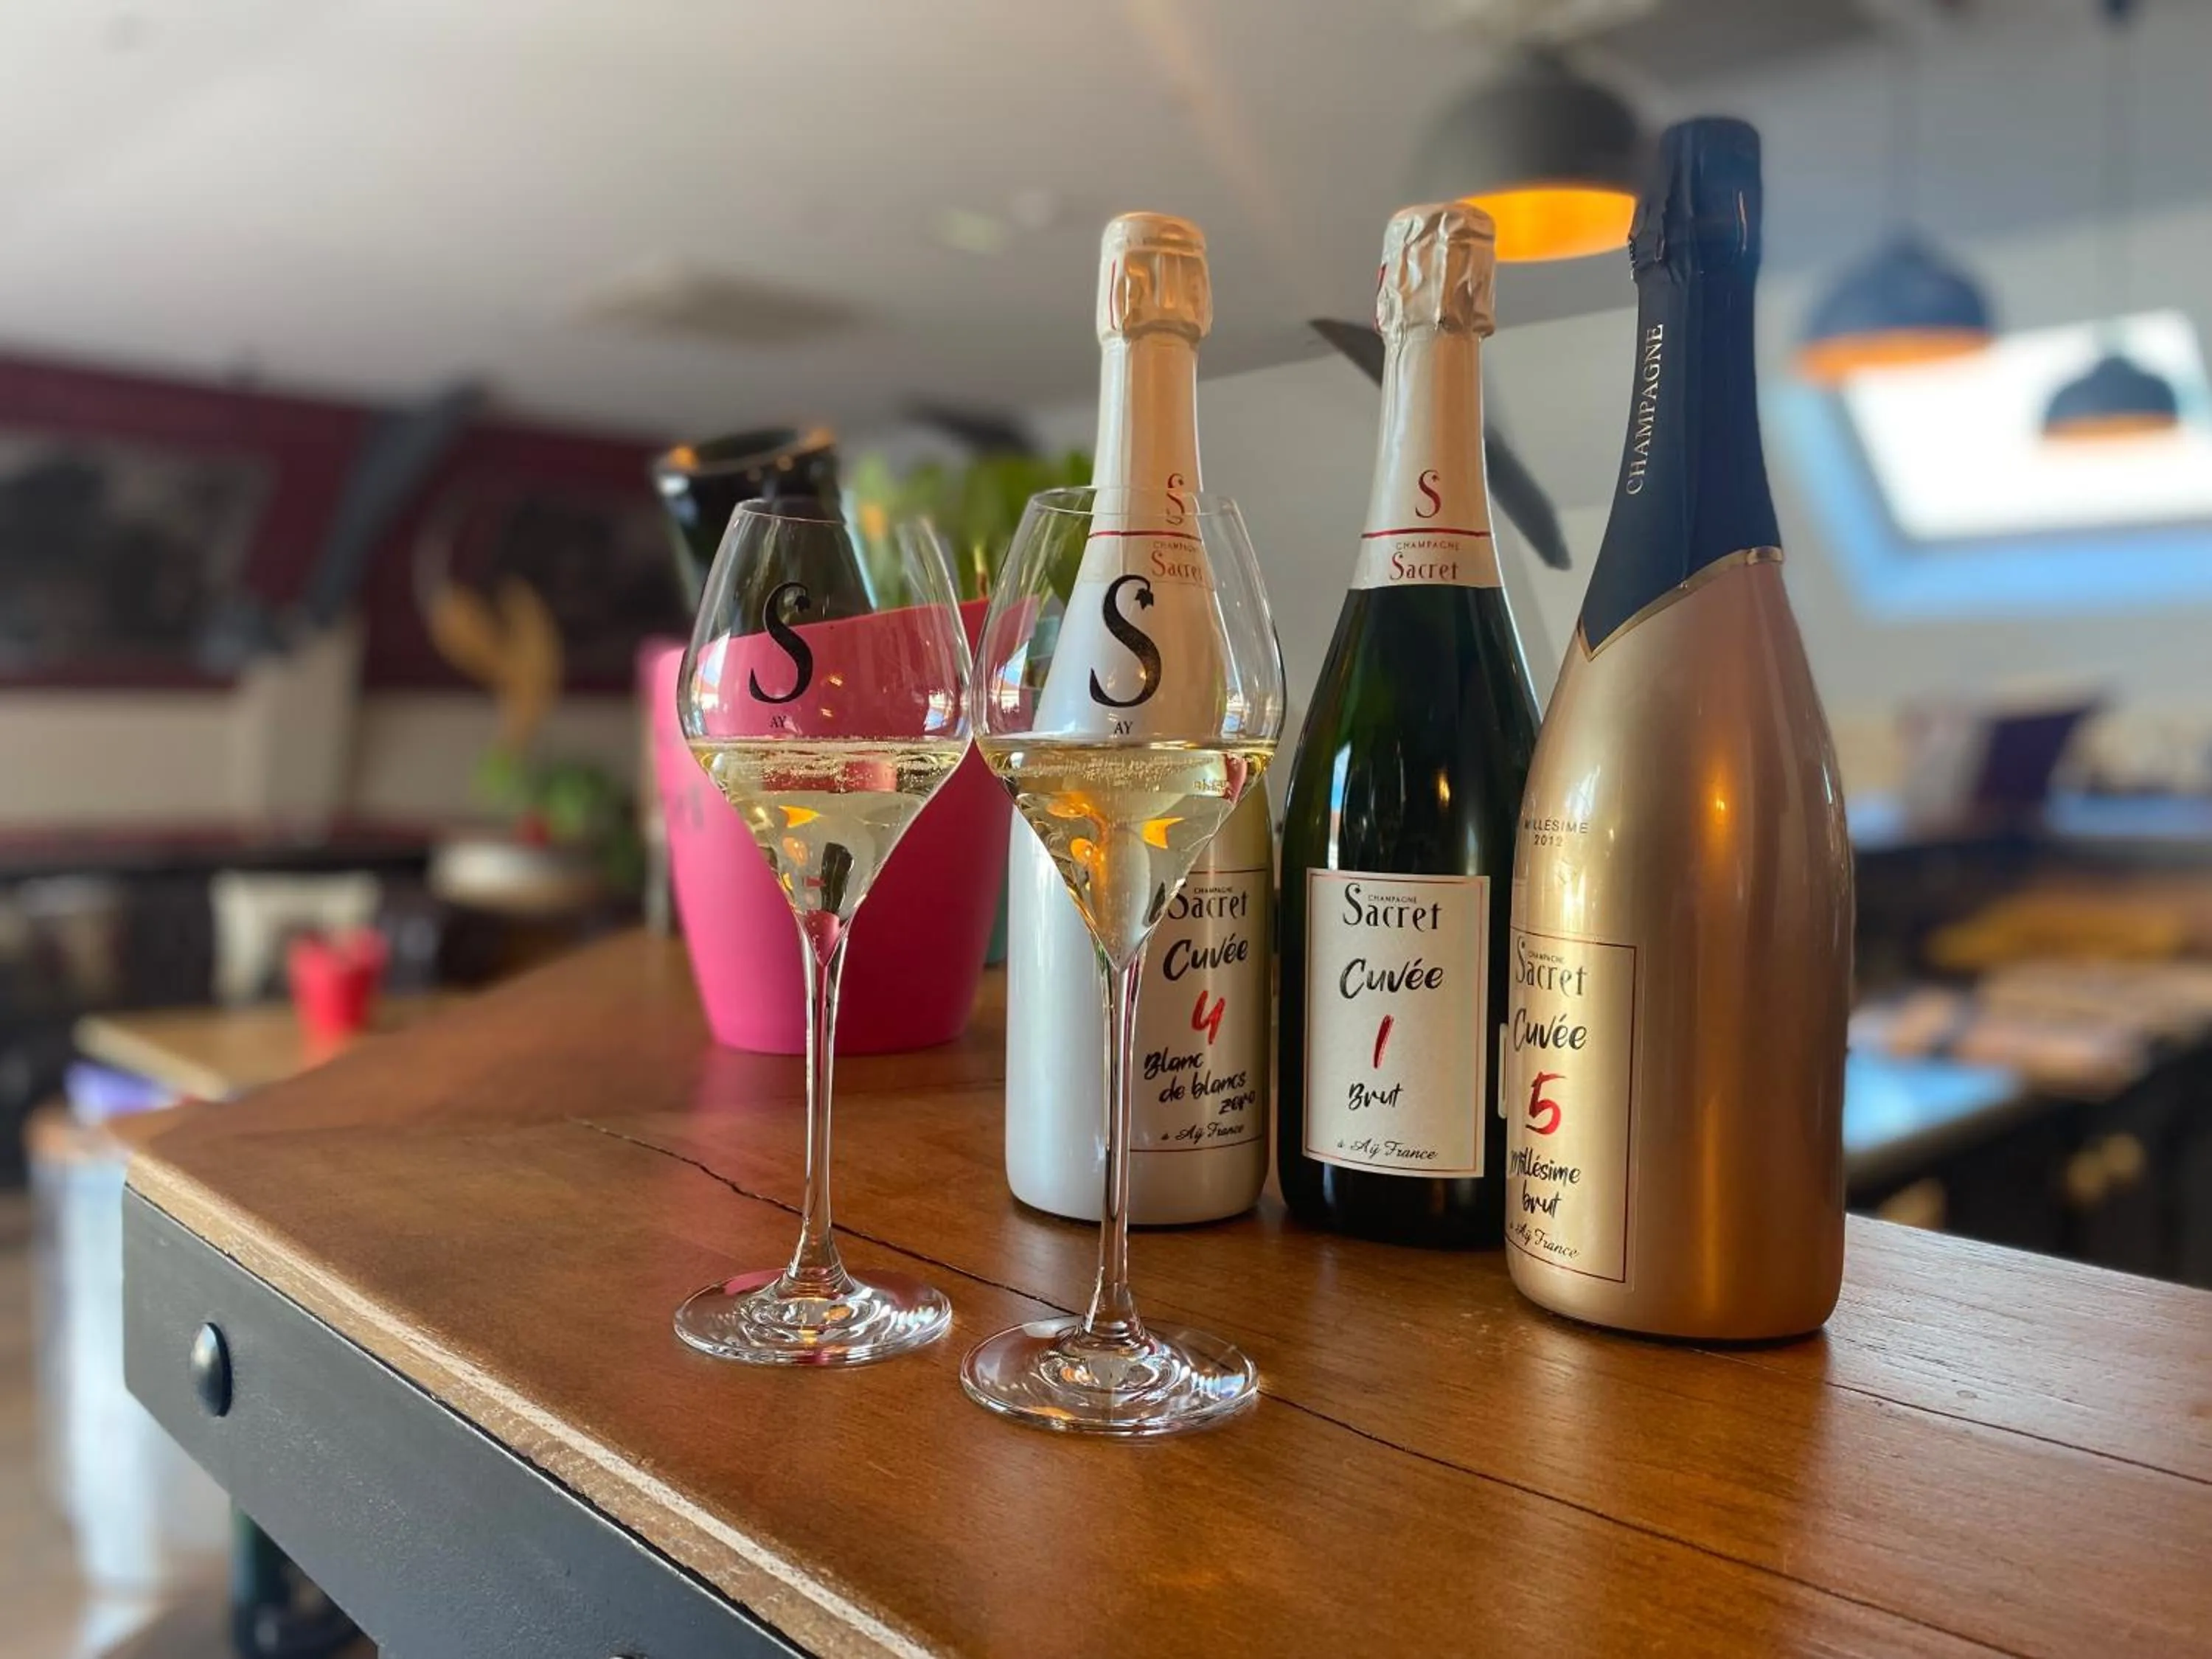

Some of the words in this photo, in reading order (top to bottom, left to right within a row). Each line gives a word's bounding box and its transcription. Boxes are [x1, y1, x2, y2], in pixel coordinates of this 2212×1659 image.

[1627, 324, 1663, 495] CHAMPAGNE
[1415, 469, 1441, 518] S
[1396, 540, 1461, 551] CHAMPAGNE
[1389, 552, 1458, 580] Sacret
[749, 582, 813, 703] S
[1089, 574, 1161, 708] S
[1114, 721, 1133, 734] AY
[1524, 818, 1589, 834] MLLESIME
[1343, 883, 1443, 932] Sacret
[1163, 933, 1248, 981] Cuvée
[1515, 935, 1588, 998] Sacret
[1340, 958, 1444, 999] Cuvée
[1514, 1008, 1587, 1052] Cuvée
[1144, 1047, 1204, 1080] Blanc
[1158, 1076, 1185, 1102] de
[1192, 1071, 1246, 1099] blancs
[1349, 1082, 1403, 1110] Brut
[1526, 1071, 1567, 1135] 5
[1384, 1141, 1438, 1160] France
[1522, 1180, 1562, 1219] brut
[1534, 1228, 1579, 1258] France
